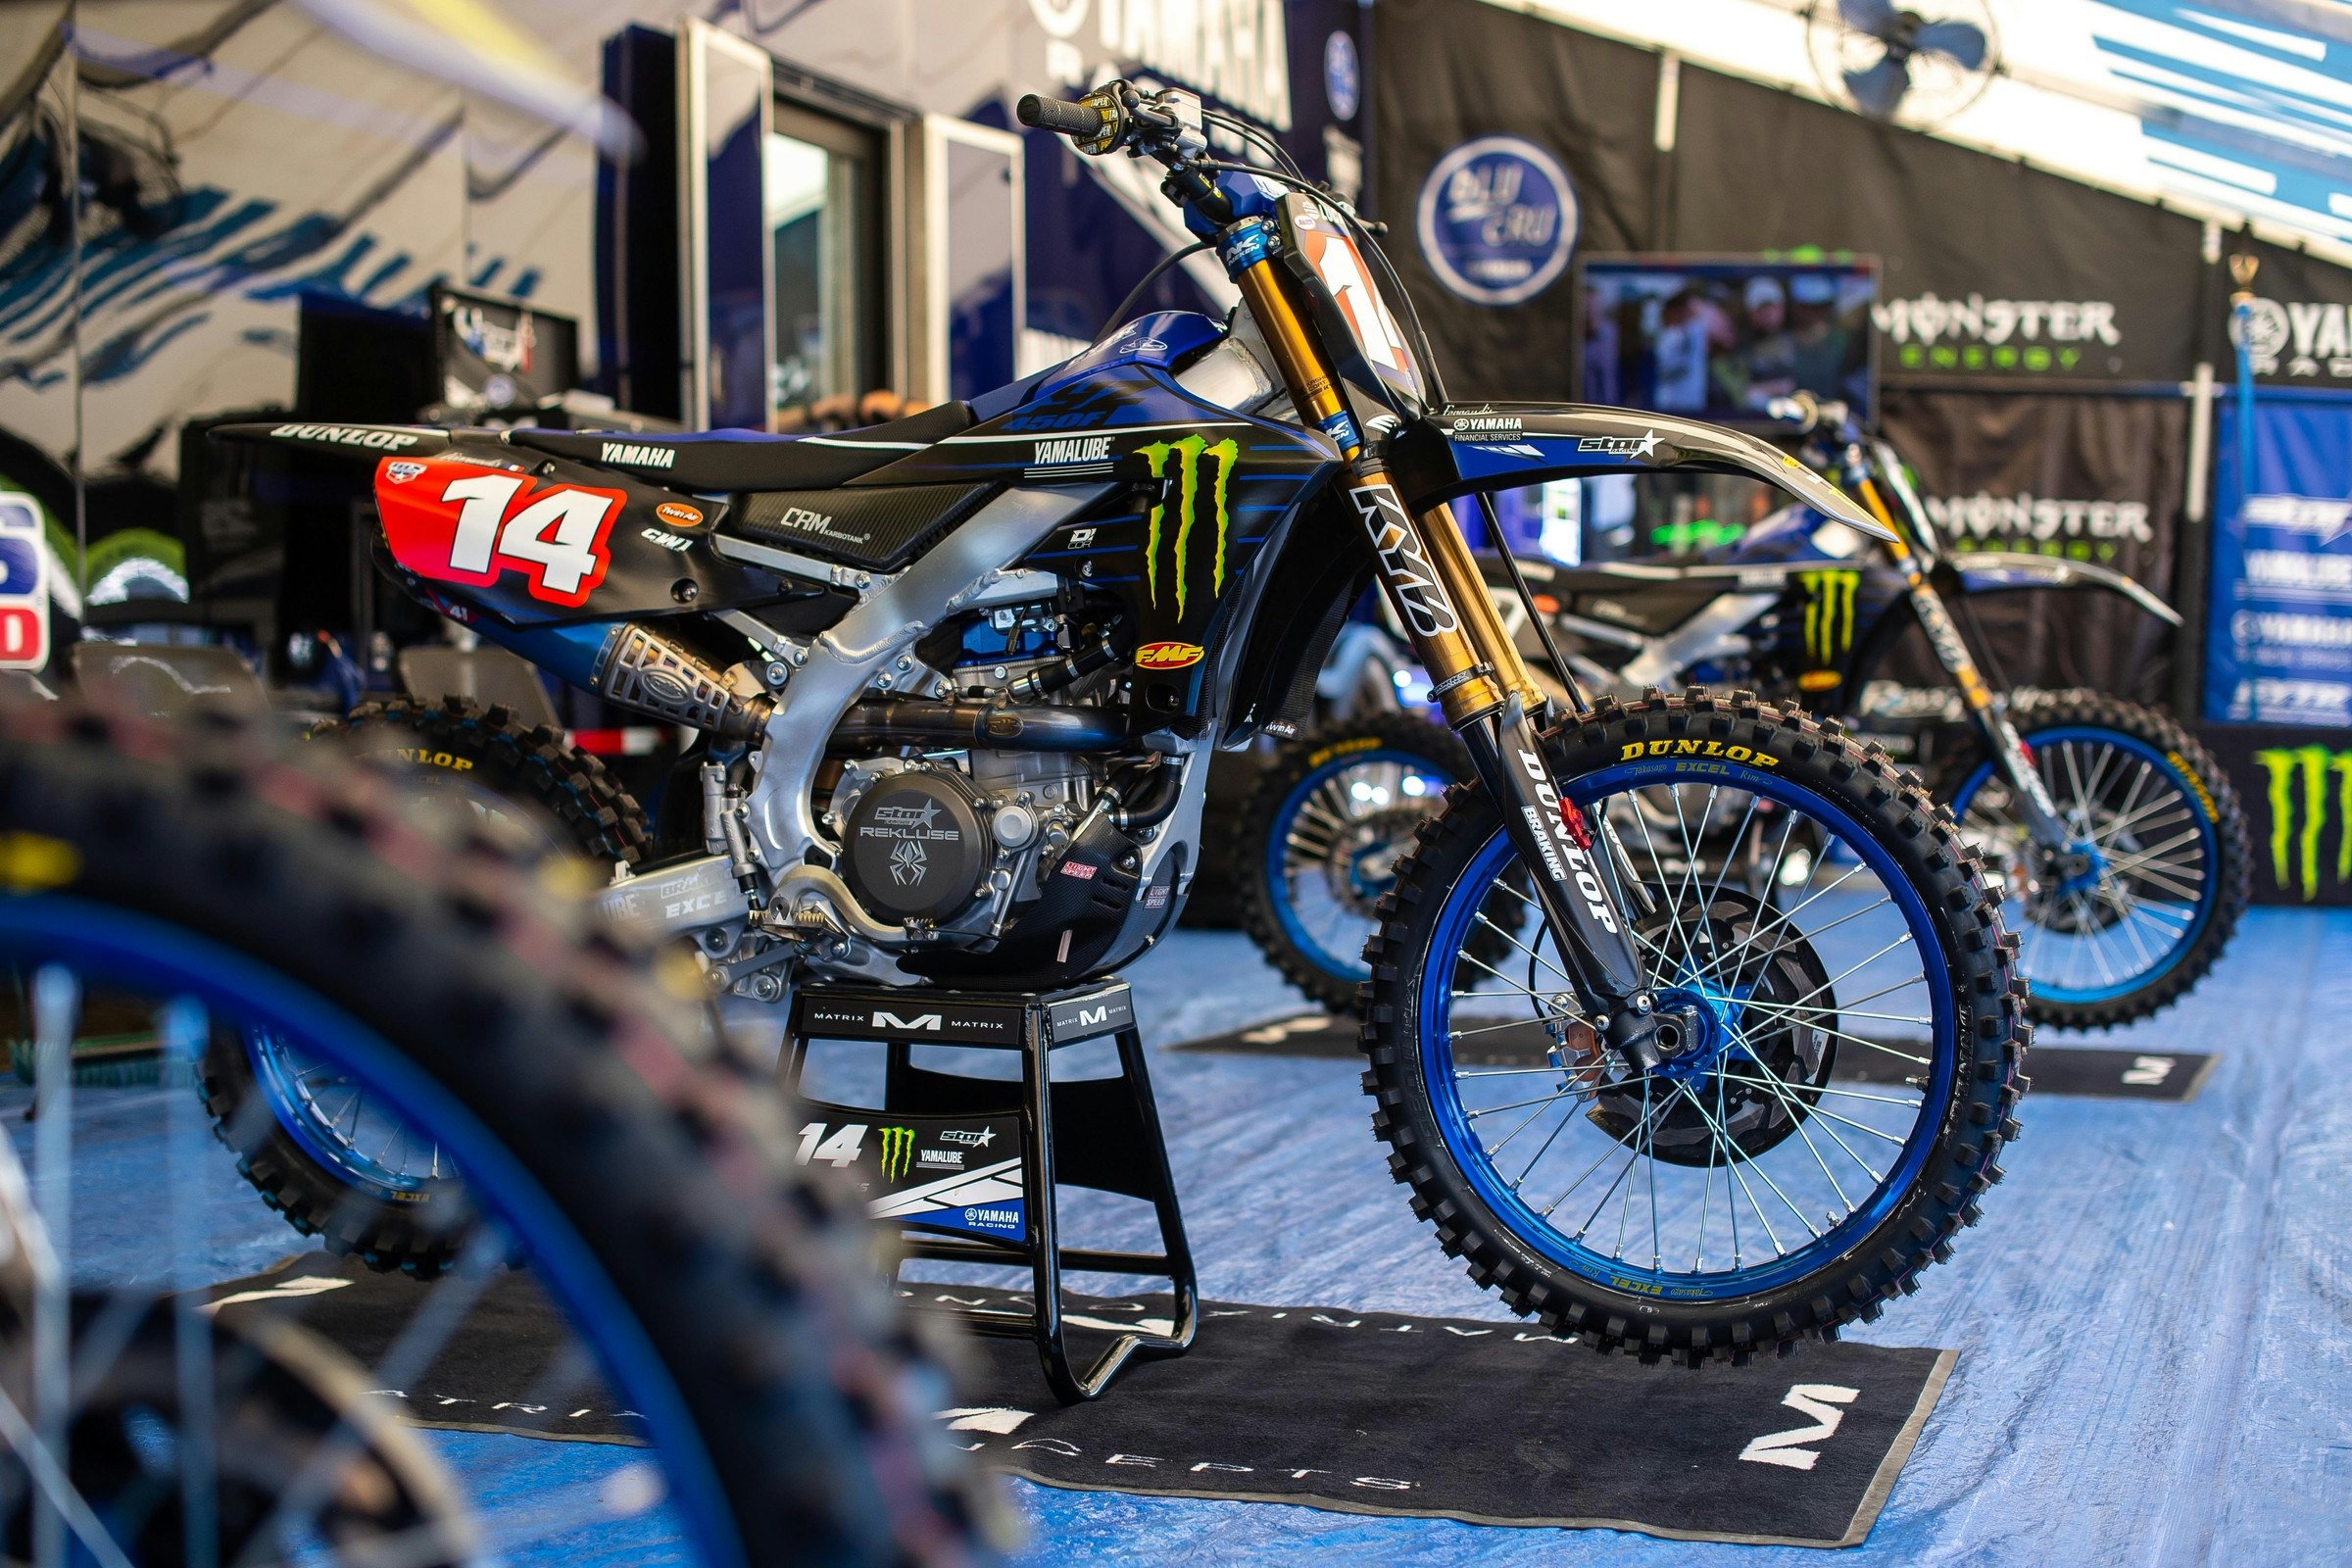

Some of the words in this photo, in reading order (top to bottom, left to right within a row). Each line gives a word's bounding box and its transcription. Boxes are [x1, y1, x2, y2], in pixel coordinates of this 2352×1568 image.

[1870, 292, 2122, 345] MONSTER
[1470, 417, 1523, 430] YAMAHA
[270, 424, 418, 451] DUNLOP
[1454, 433, 1489, 442] FINANCIAL
[601, 442, 676, 468] YAMAHA
[1034, 437, 1110, 465] YAMALUBE
[781, 507, 832, 534] CRM
[441, 473, 614, 595] 14
[1135, 645, 1203, 663] FMF
[1620, 739, 1780, 767] DUNLOP
[1675, 761, 1731, 775] EXCEL
[860, 826, 959, 841] REKLUSE
[1518, 749, 1617, 933] DUNLOP
[1525, 807, 1567, 881] BRAKING
[1066, 862, 1097, 873] LIGHT
[1151, 886, 1170, 897] LIGHT
[665, 890, 728, 918] EXCE
[814, 1012, 864, 1021] MATRIX
[951, 1020, 1004, 1029] MATRIX
[1056, 1017, 1079, 1027] MATRIX
[794, 1122, 868, 1167] 14
[921, 1150, 962, 1163] YAMALUBE
[977, 1208, 1019, 1224] YAMAHA
[1610, 1276, 1664, 1295] EXCEL
